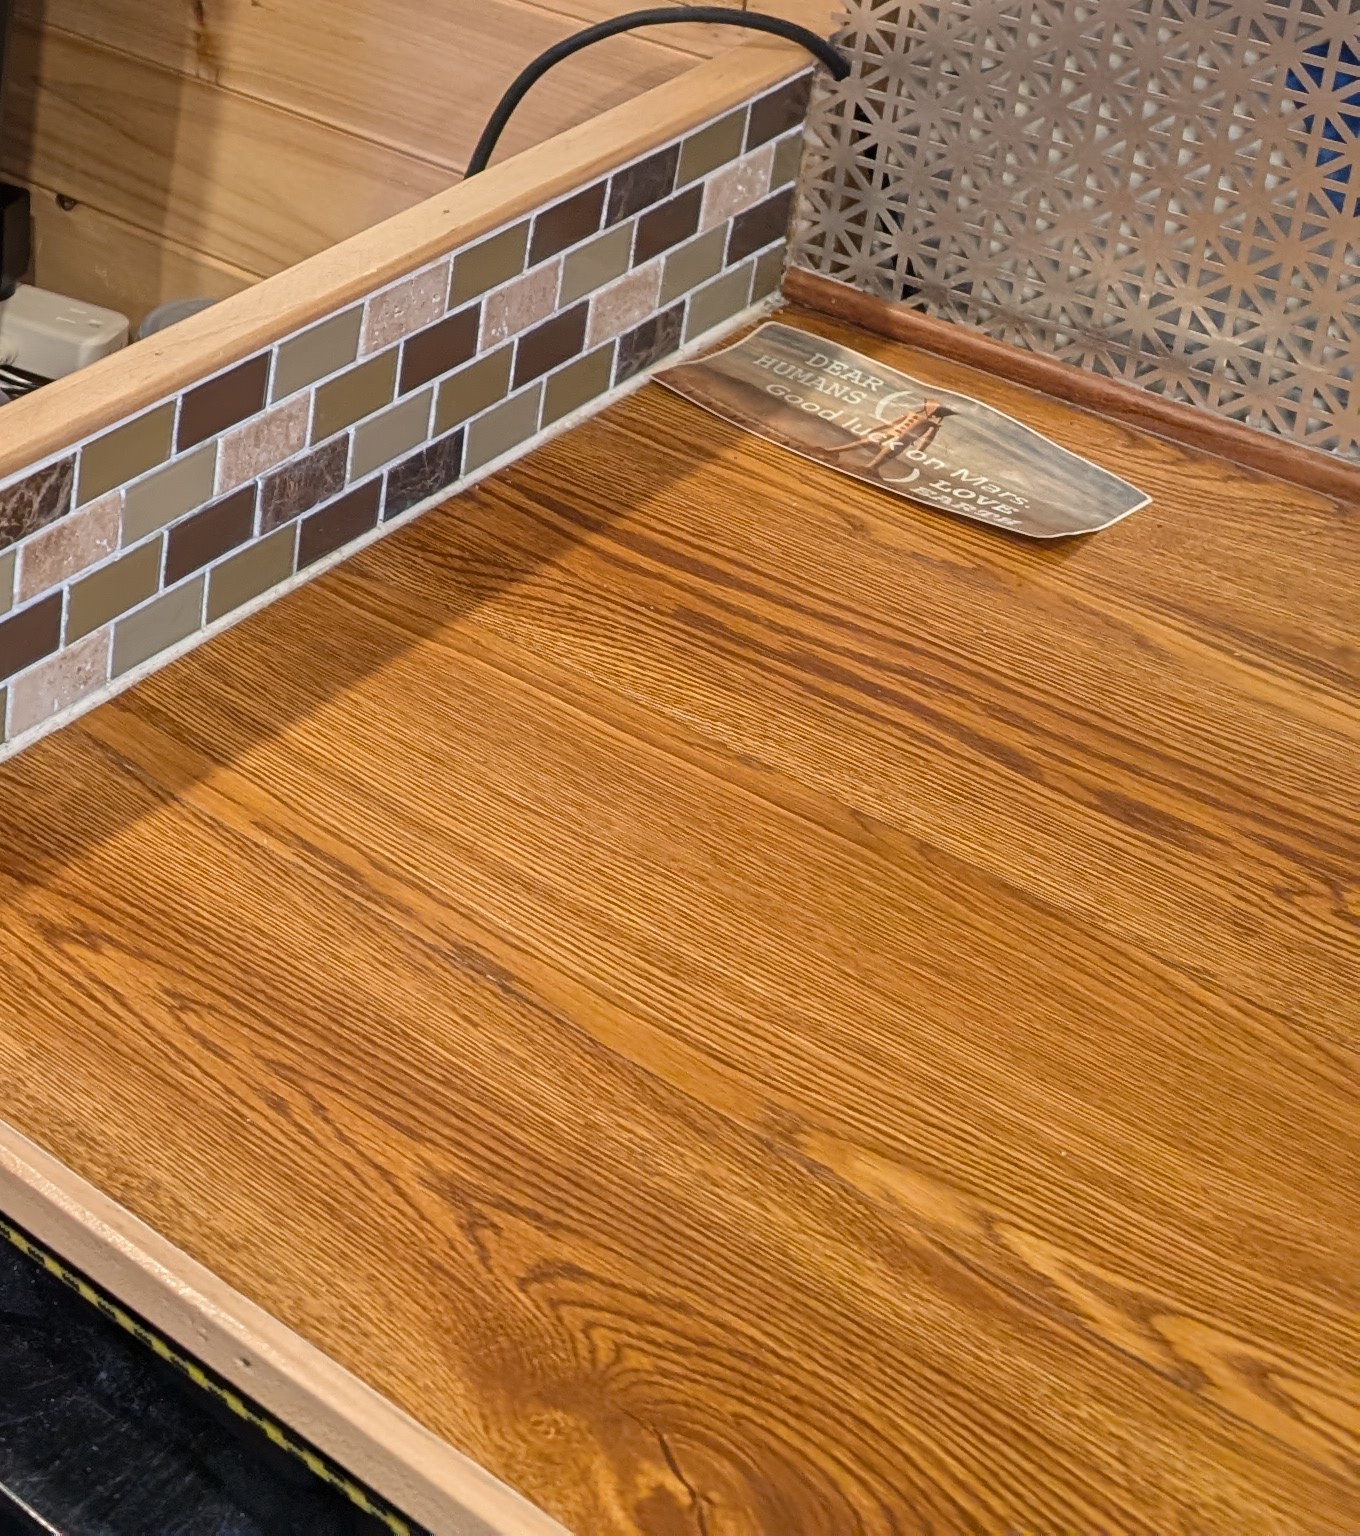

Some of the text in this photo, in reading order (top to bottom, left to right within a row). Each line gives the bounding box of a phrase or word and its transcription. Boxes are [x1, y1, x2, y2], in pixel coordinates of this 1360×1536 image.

[753, 354, 868, 406] HUMANS
[804, 353, 885, 392] DEAR
[765, 384, 1031, 509] Good luck on Mars.
[910, 486, 1023, 526] EARTH
[929, 479, 1020, 515] LOVE
